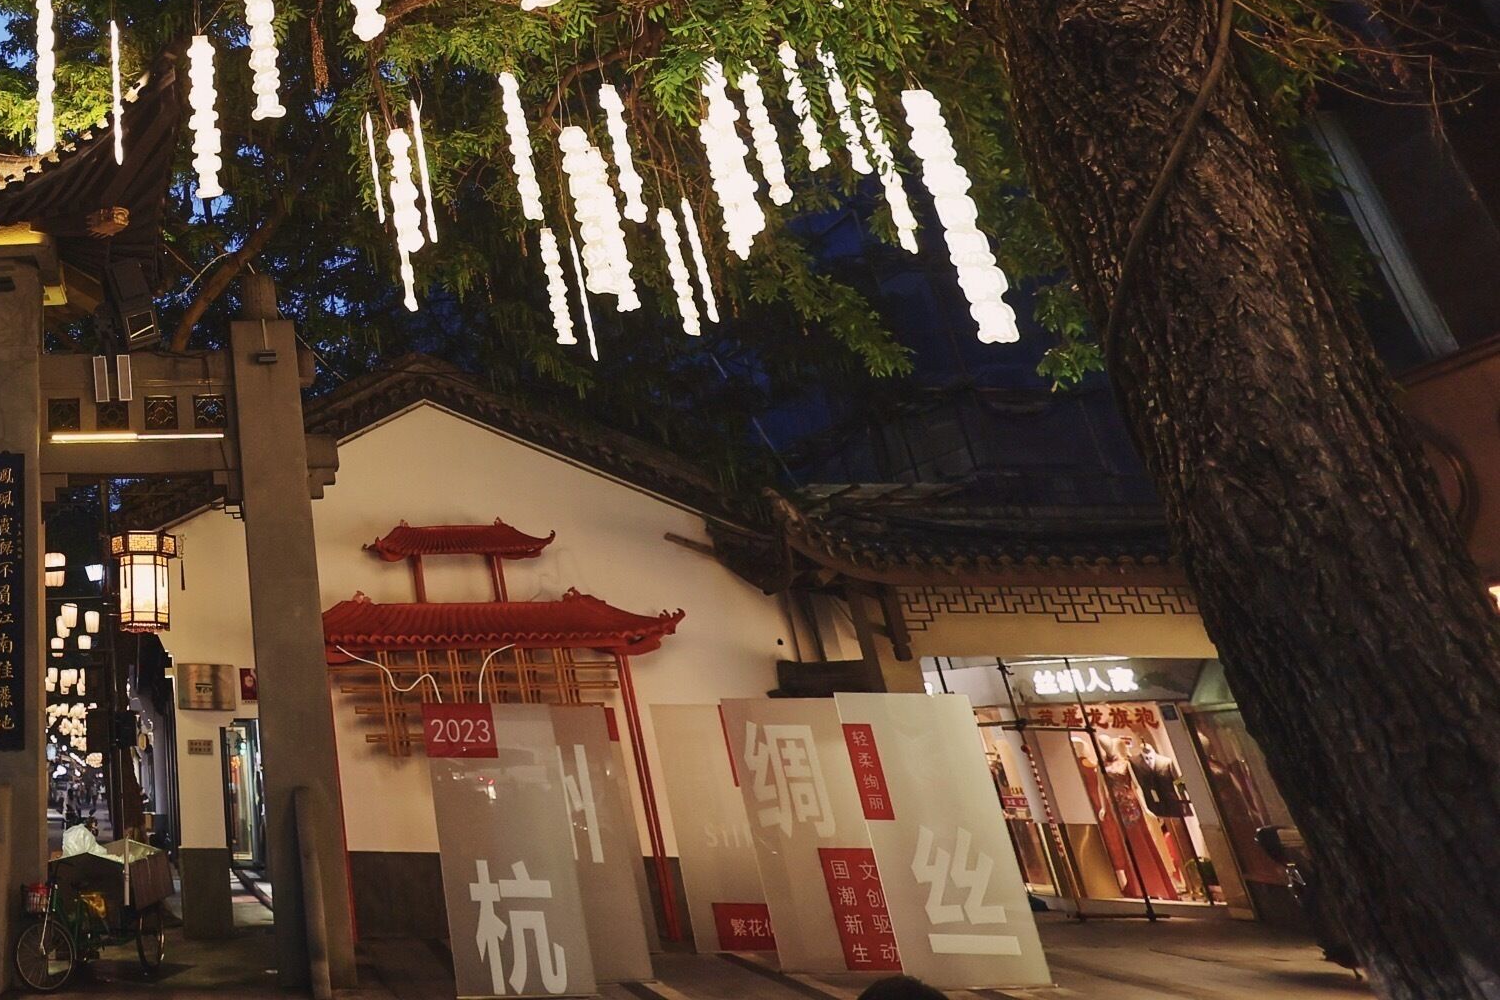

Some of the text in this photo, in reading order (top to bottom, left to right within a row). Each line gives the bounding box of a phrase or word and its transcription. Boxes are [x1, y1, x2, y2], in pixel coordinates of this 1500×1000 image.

[430, 719, 491, 743] 2023
[1033, 667, 1139, 694] 丝绸人家
[743, 721, 836, 839] 绸
[852, 730, 884, 811] 轻柔绚丽
[468, 859, 569, 996] 杭
[831, 860, 873, 964] 国潮新生
[858, 860, 901, 963] 文创驱动
[911, 826, 1022, 957] 丝
